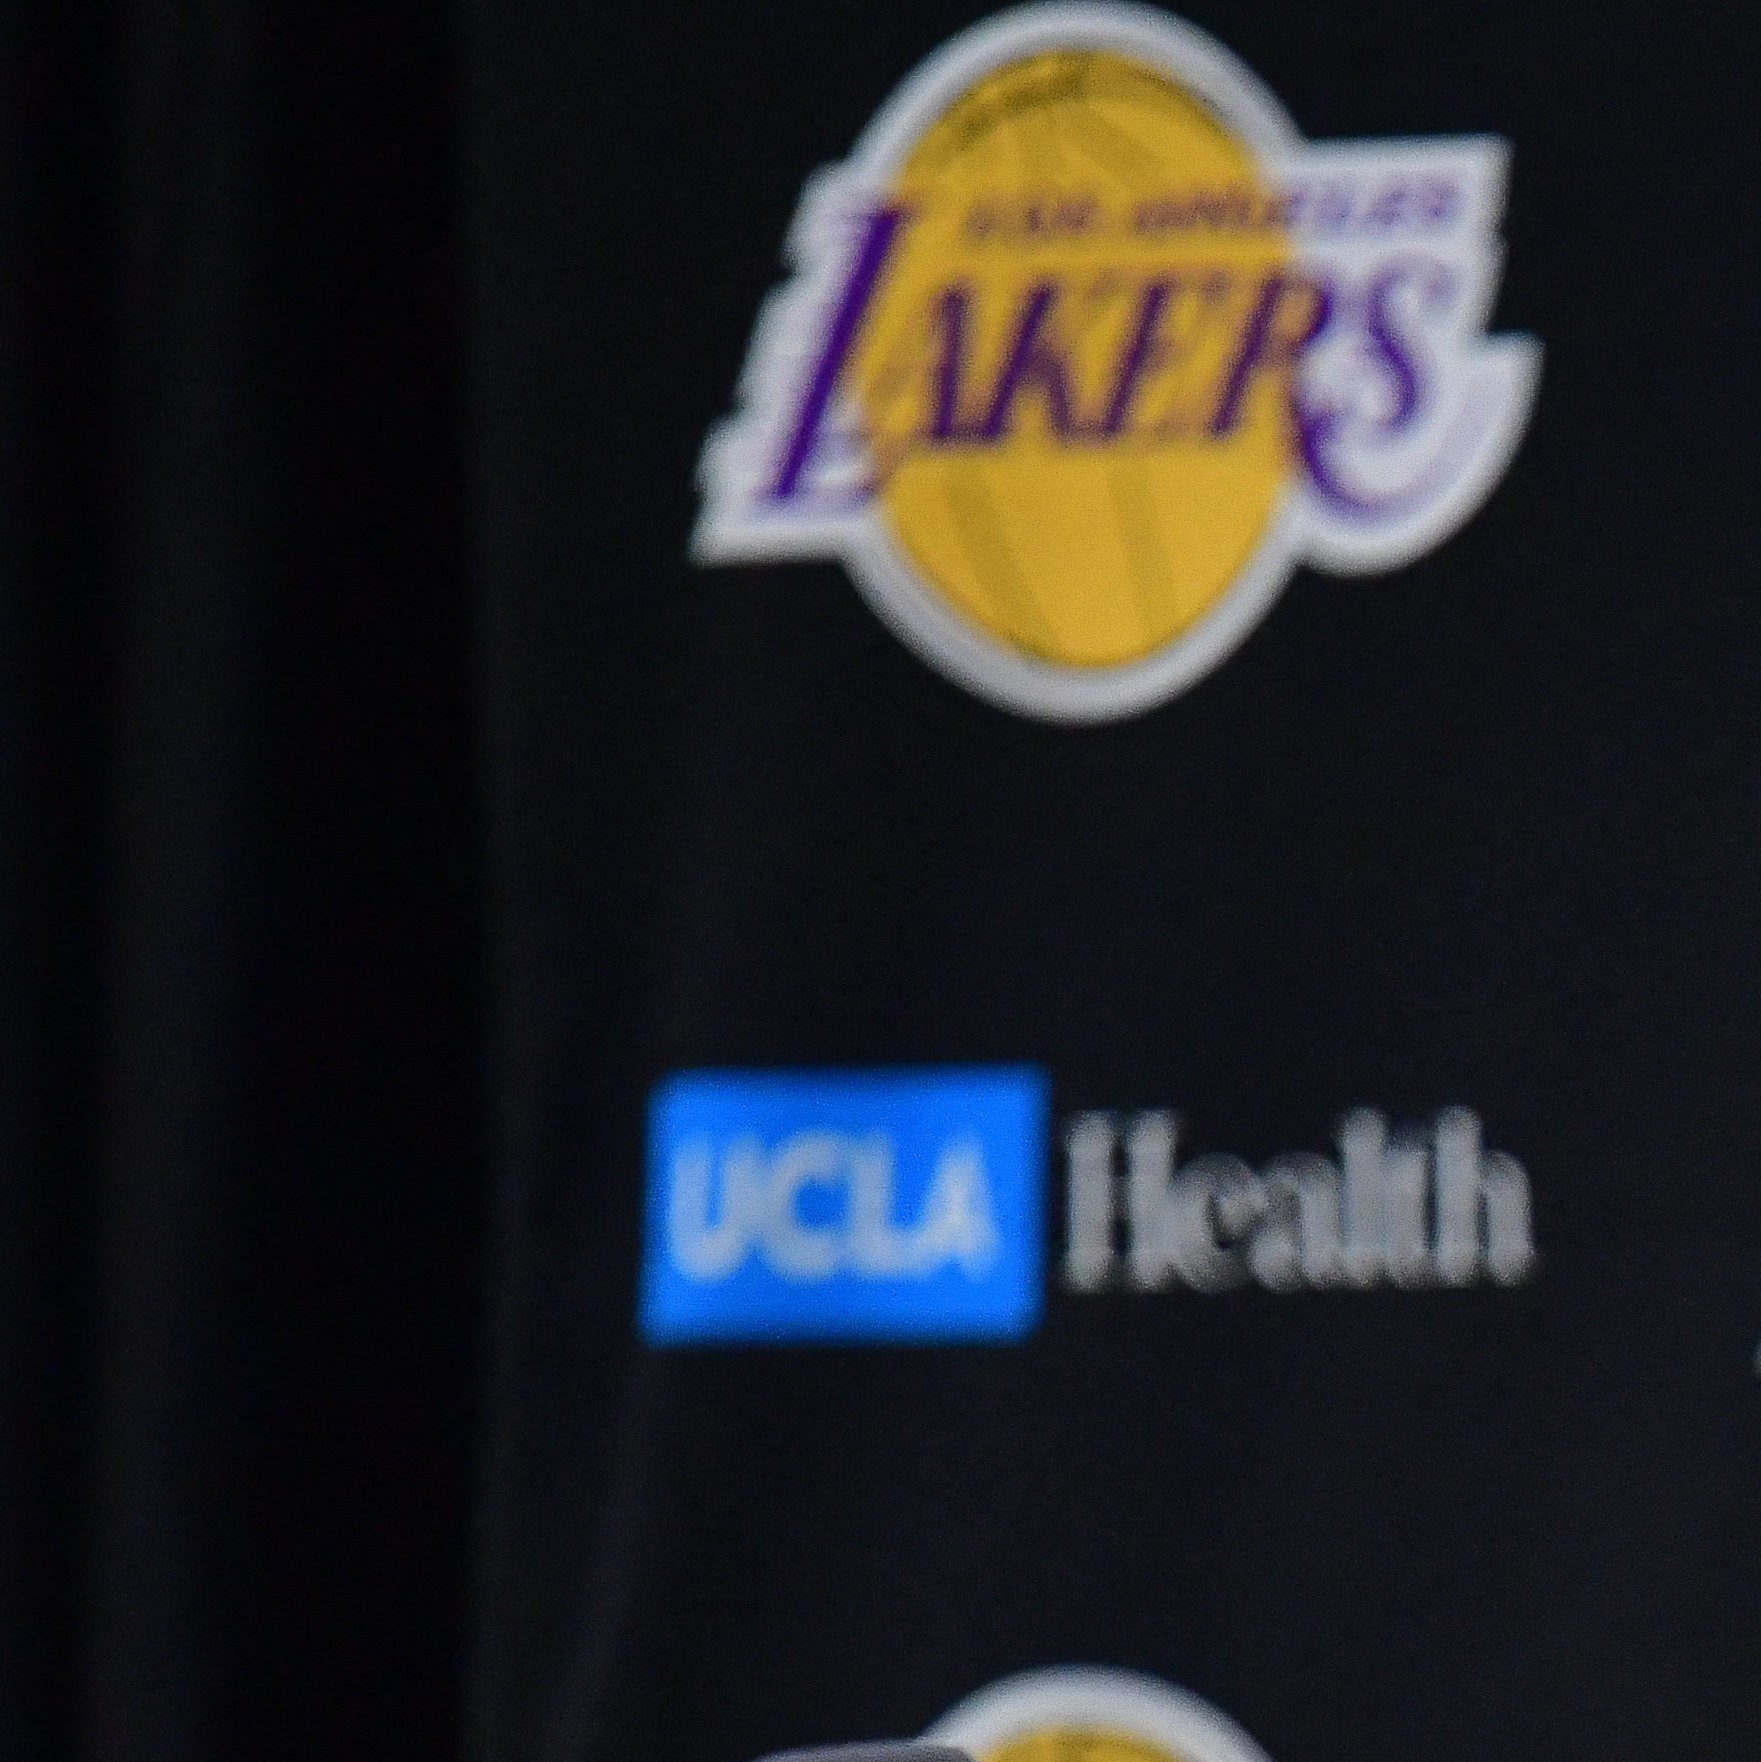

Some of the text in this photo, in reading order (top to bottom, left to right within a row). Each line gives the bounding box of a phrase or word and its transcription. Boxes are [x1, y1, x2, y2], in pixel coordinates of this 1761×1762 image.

[748, 198, 1490, 530] LAKERS
[664, 1103, 1537, 1294] UCLA Health
